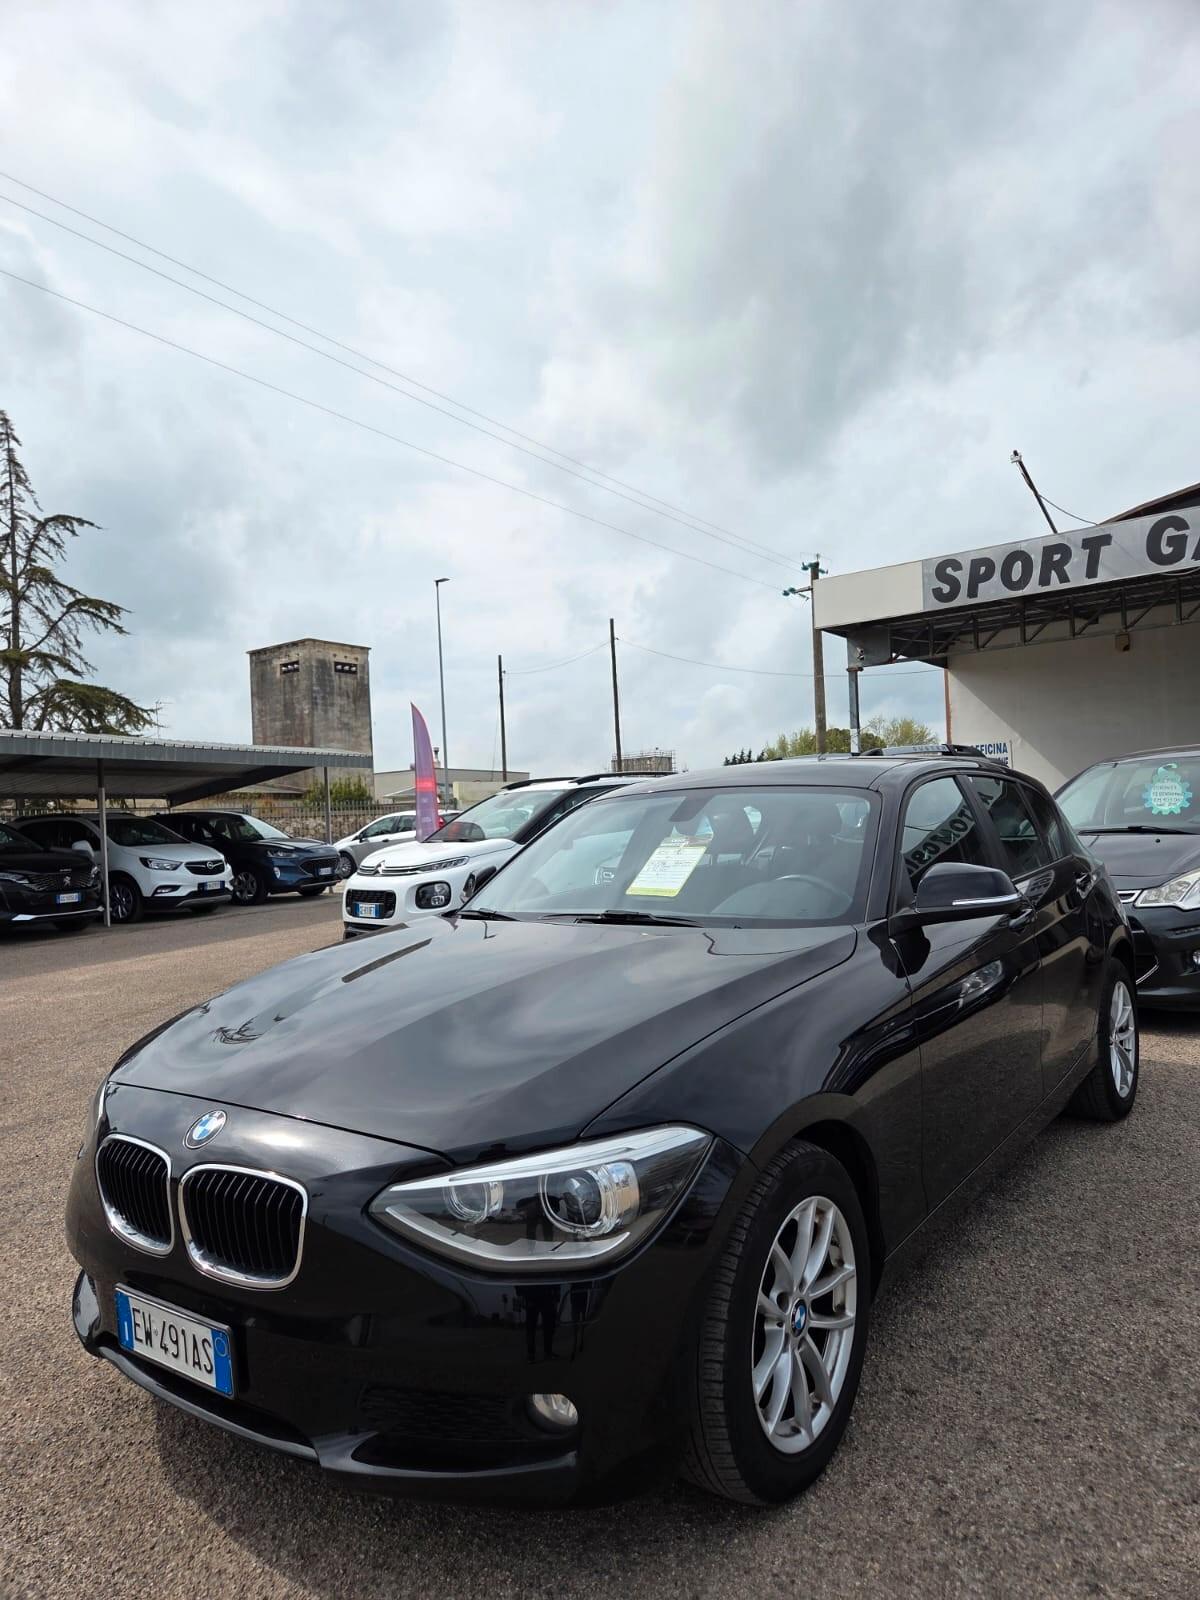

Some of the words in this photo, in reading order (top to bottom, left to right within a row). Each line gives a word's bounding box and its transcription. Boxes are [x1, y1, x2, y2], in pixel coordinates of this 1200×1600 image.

[931, 533, 1112, 603] SPORT
[1146, 515, 1200, 566] G
[974, 742, 1008, 755] FFICINA
